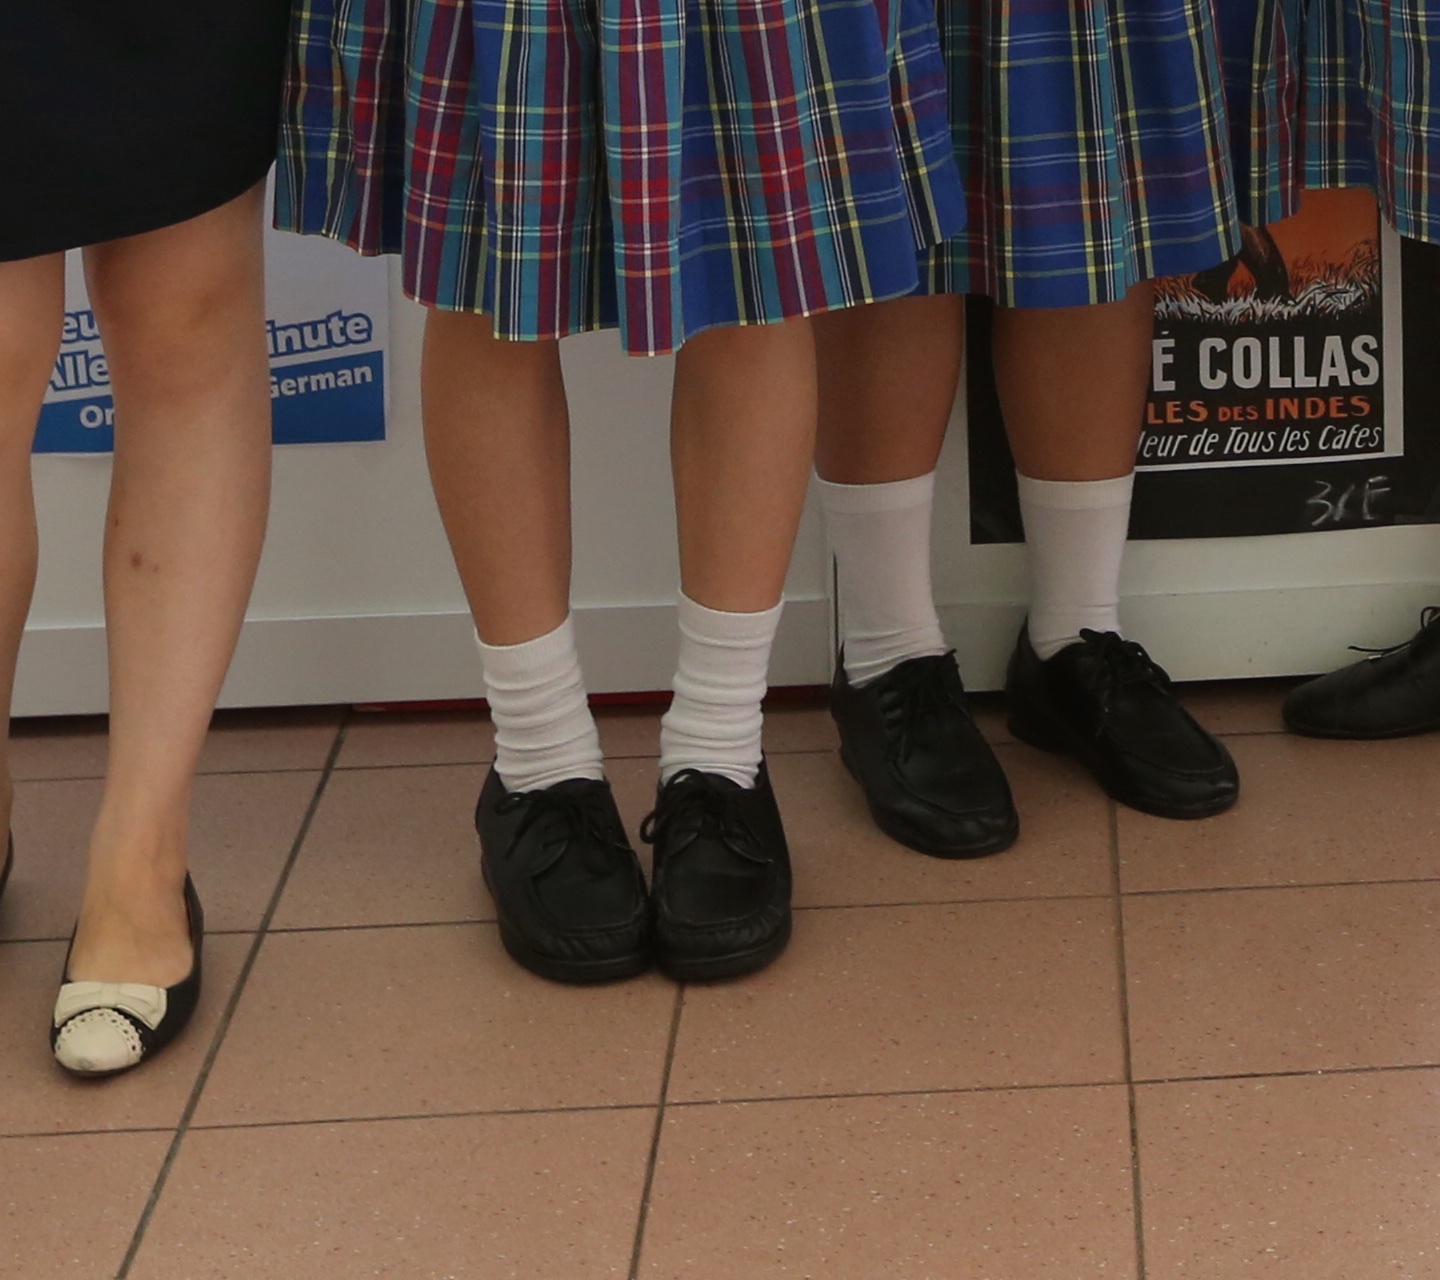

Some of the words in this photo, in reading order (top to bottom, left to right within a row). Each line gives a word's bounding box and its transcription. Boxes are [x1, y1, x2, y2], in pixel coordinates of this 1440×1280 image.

[266, 310, 372, 357] inute
[1198, 334, 1381, 391] COLLAS
[1146, 400, 1210, 424] LES
[1217, 405, 1260, 422] DES
[1265, 395, 1372, 421] INDES
[1188, 428, 1220, 455] de
[1223, 426, 1277, 455] Tous
[1277, 426, 1311, 453] les
